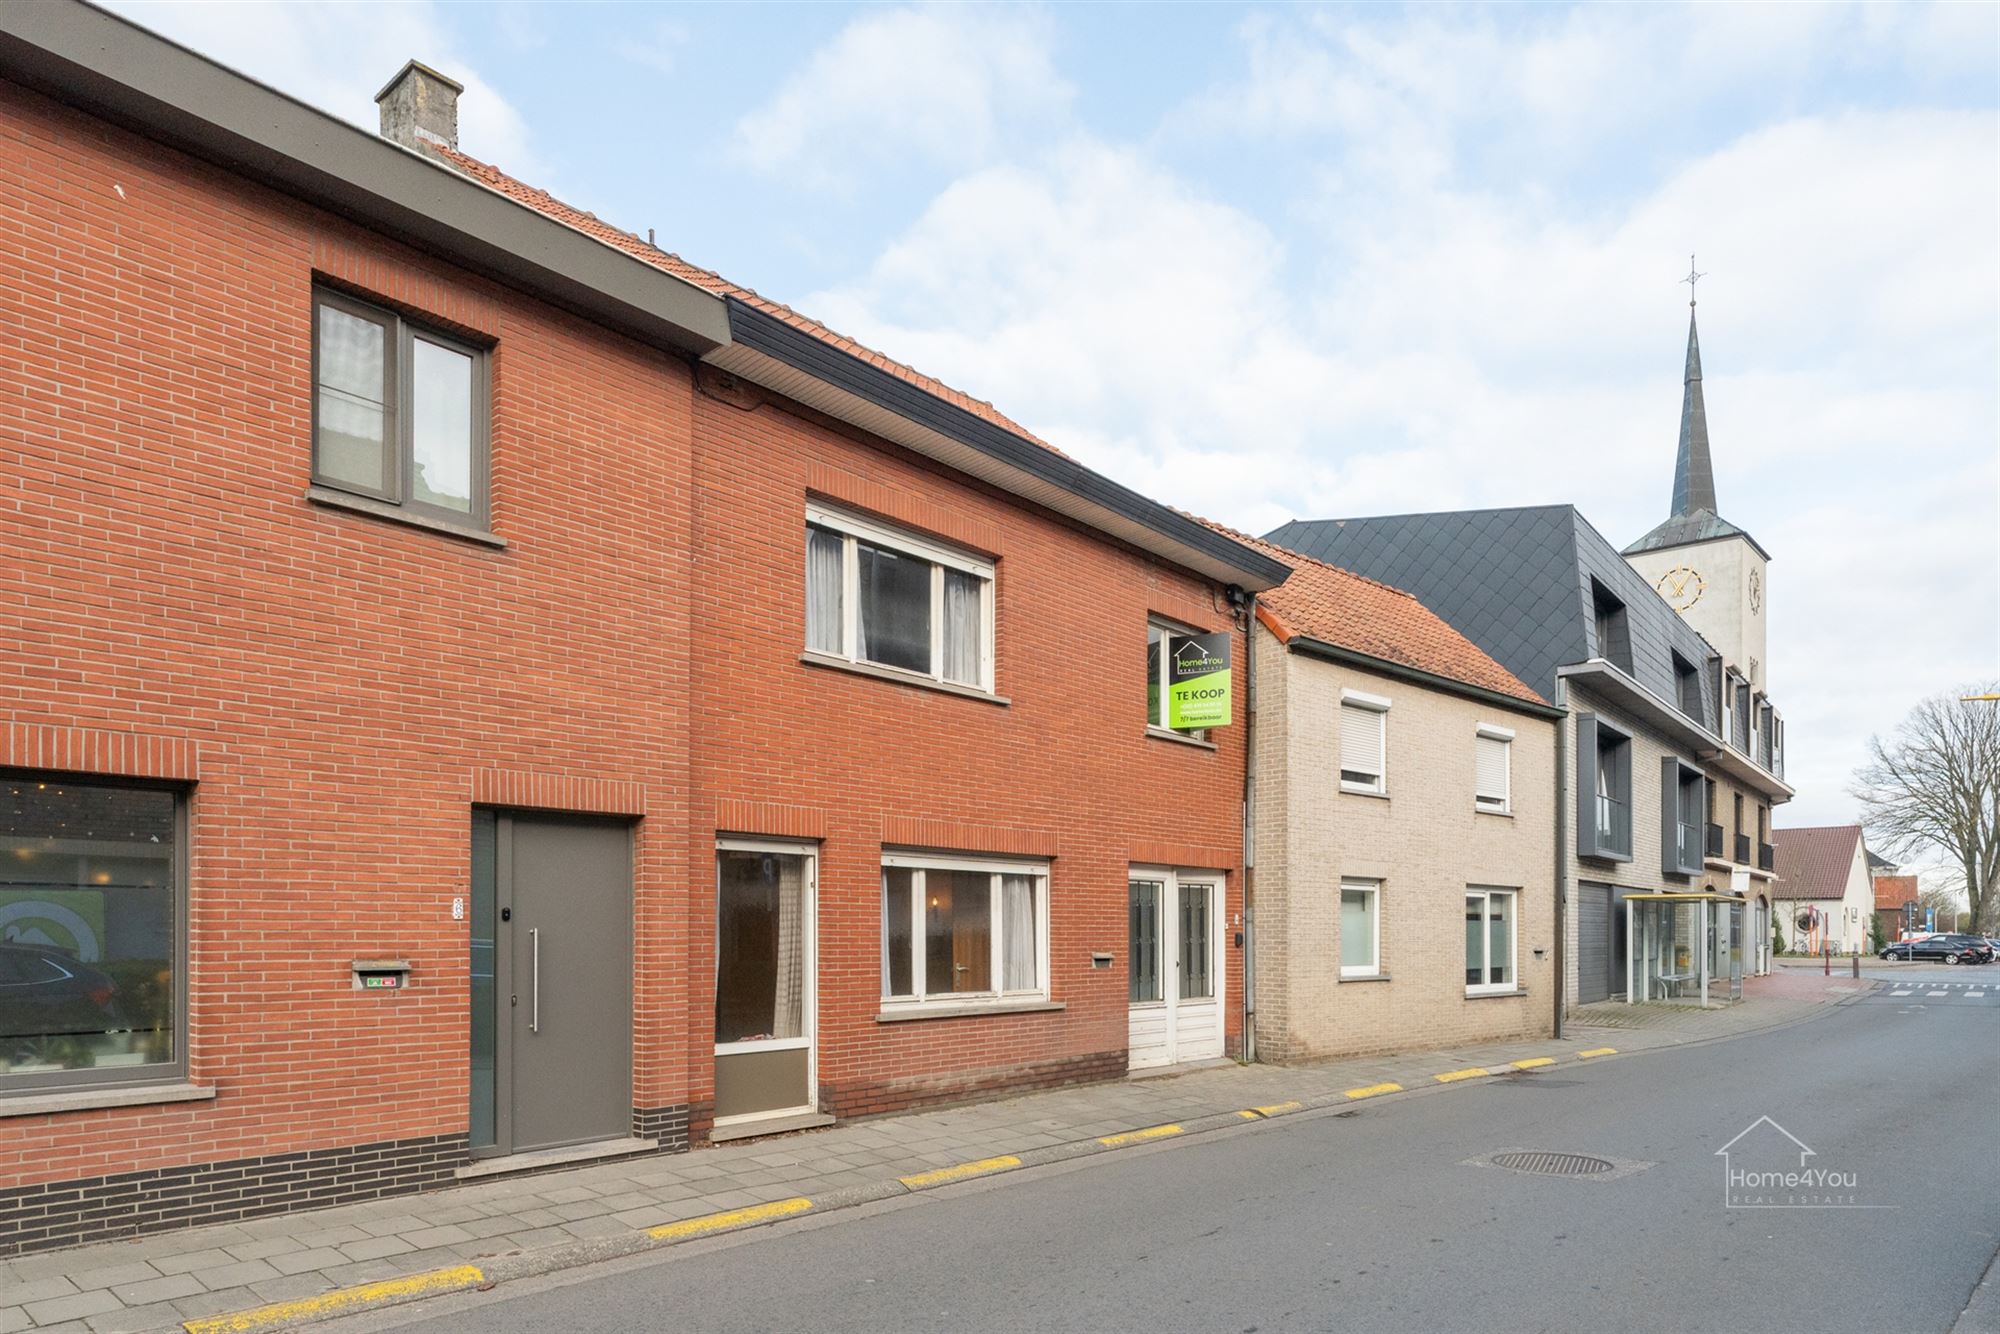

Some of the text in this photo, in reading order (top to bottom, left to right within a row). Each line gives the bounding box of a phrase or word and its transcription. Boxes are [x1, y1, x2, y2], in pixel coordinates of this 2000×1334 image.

[1179, 657, 1223, 667] Home4You
[1175, 688, 1225, 700] TE KOOP
